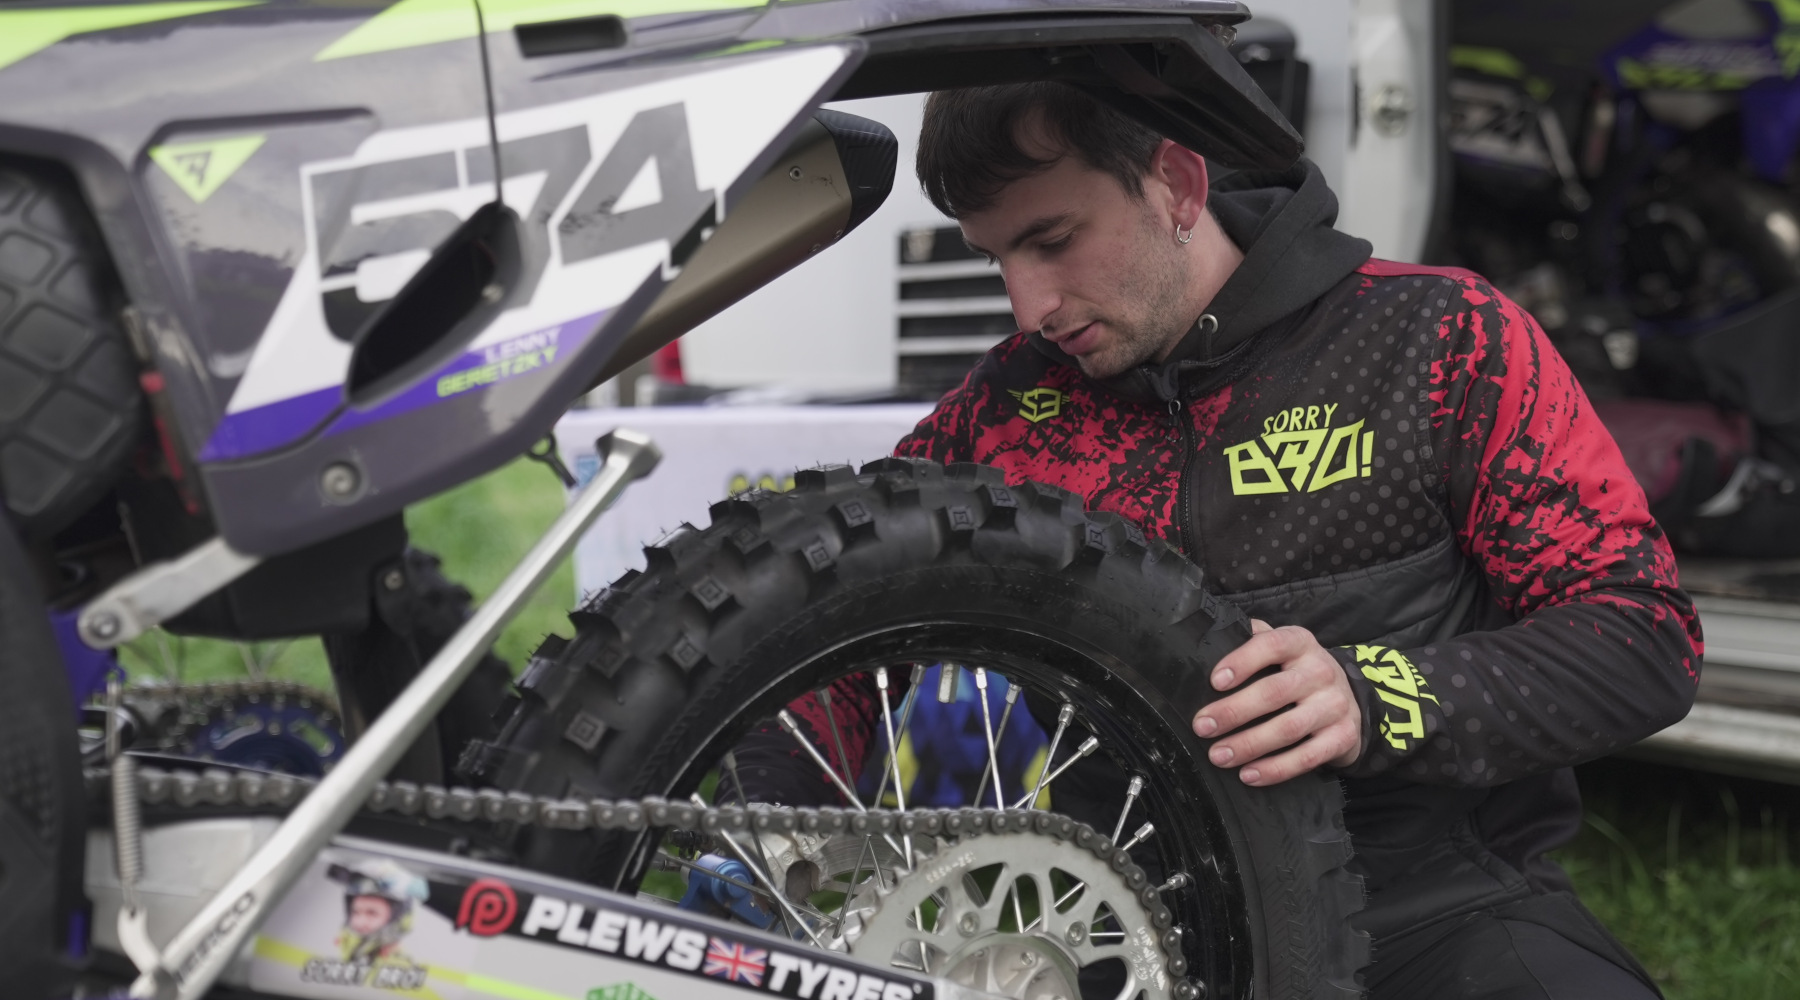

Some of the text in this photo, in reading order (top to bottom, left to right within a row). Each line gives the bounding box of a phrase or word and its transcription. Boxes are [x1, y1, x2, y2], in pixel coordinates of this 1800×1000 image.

[485, 324, 561, 363] LENNY
[1260, 403, 1338, 437] SORRY
[1223, 418, 1374, 495] BRO!
[521, 895, 707, 971] PLEWS
